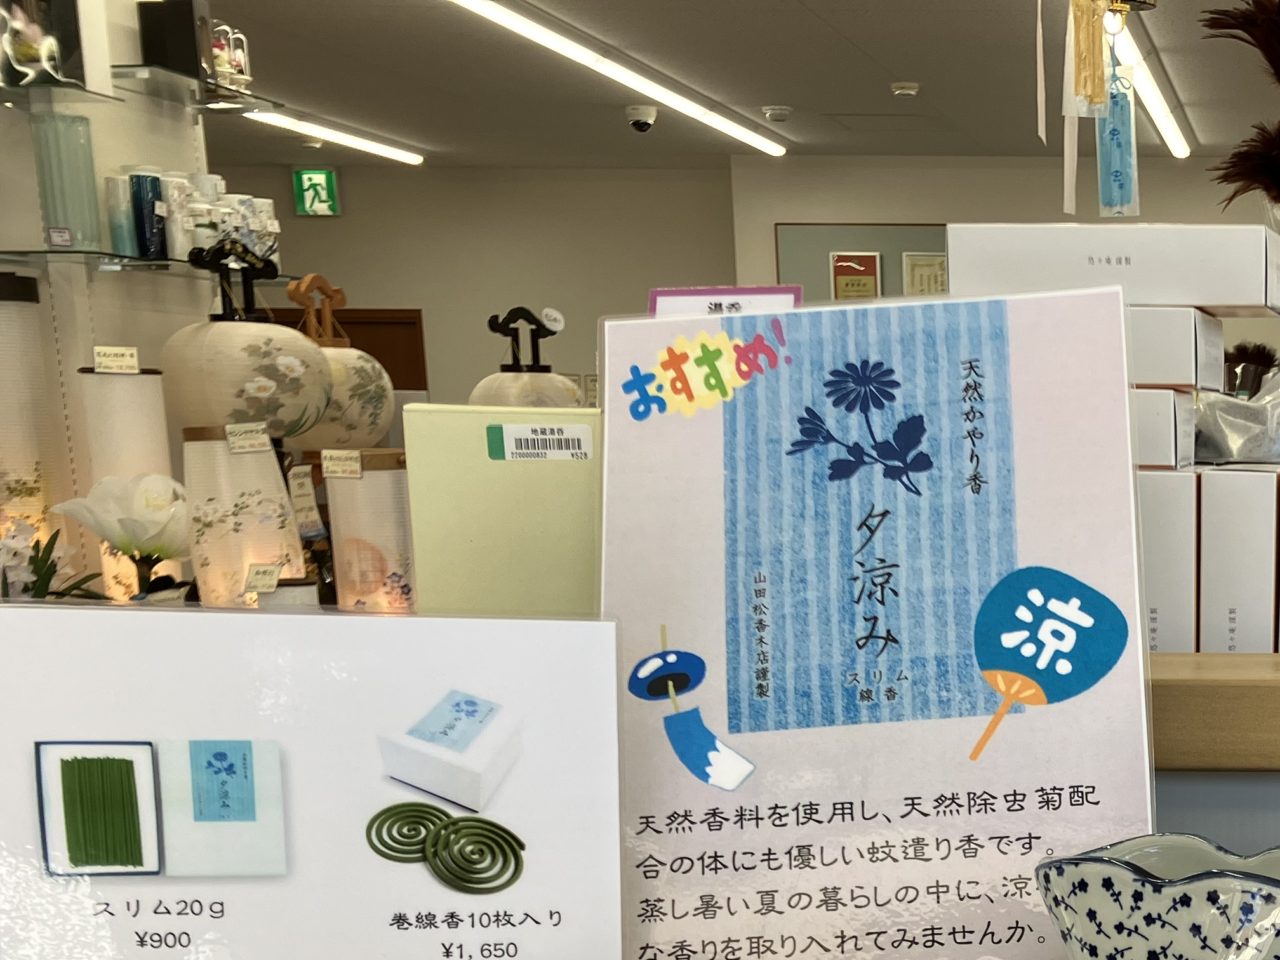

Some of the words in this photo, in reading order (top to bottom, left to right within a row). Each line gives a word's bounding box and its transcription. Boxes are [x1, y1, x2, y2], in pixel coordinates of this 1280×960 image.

[959, 357, 989, 496] 天然かやり香
[850, 503, 900, 657] 夕涼み
[753, 571, 771, 698] 山田松香木店謹製
[1001, 587, 1096, 676] 涼
[847, 669, 910, 686] スリム
[858, 686, 899, 703] 線香
[635, 783, 1100, 837] 天然香料を使用し、天然除虫菊配
[635, 831, 1056, 881] 合の体にも優しい蚊遣り香です。
[93, 899, 226, 919] スリム20g
[389, 910, 563, 931] 巻線香10枚入り
[637, 875, 1040, 925] 蒸し暑い夏の暮らしの中に、涼
[135, 929, 191, 949] ¥900
